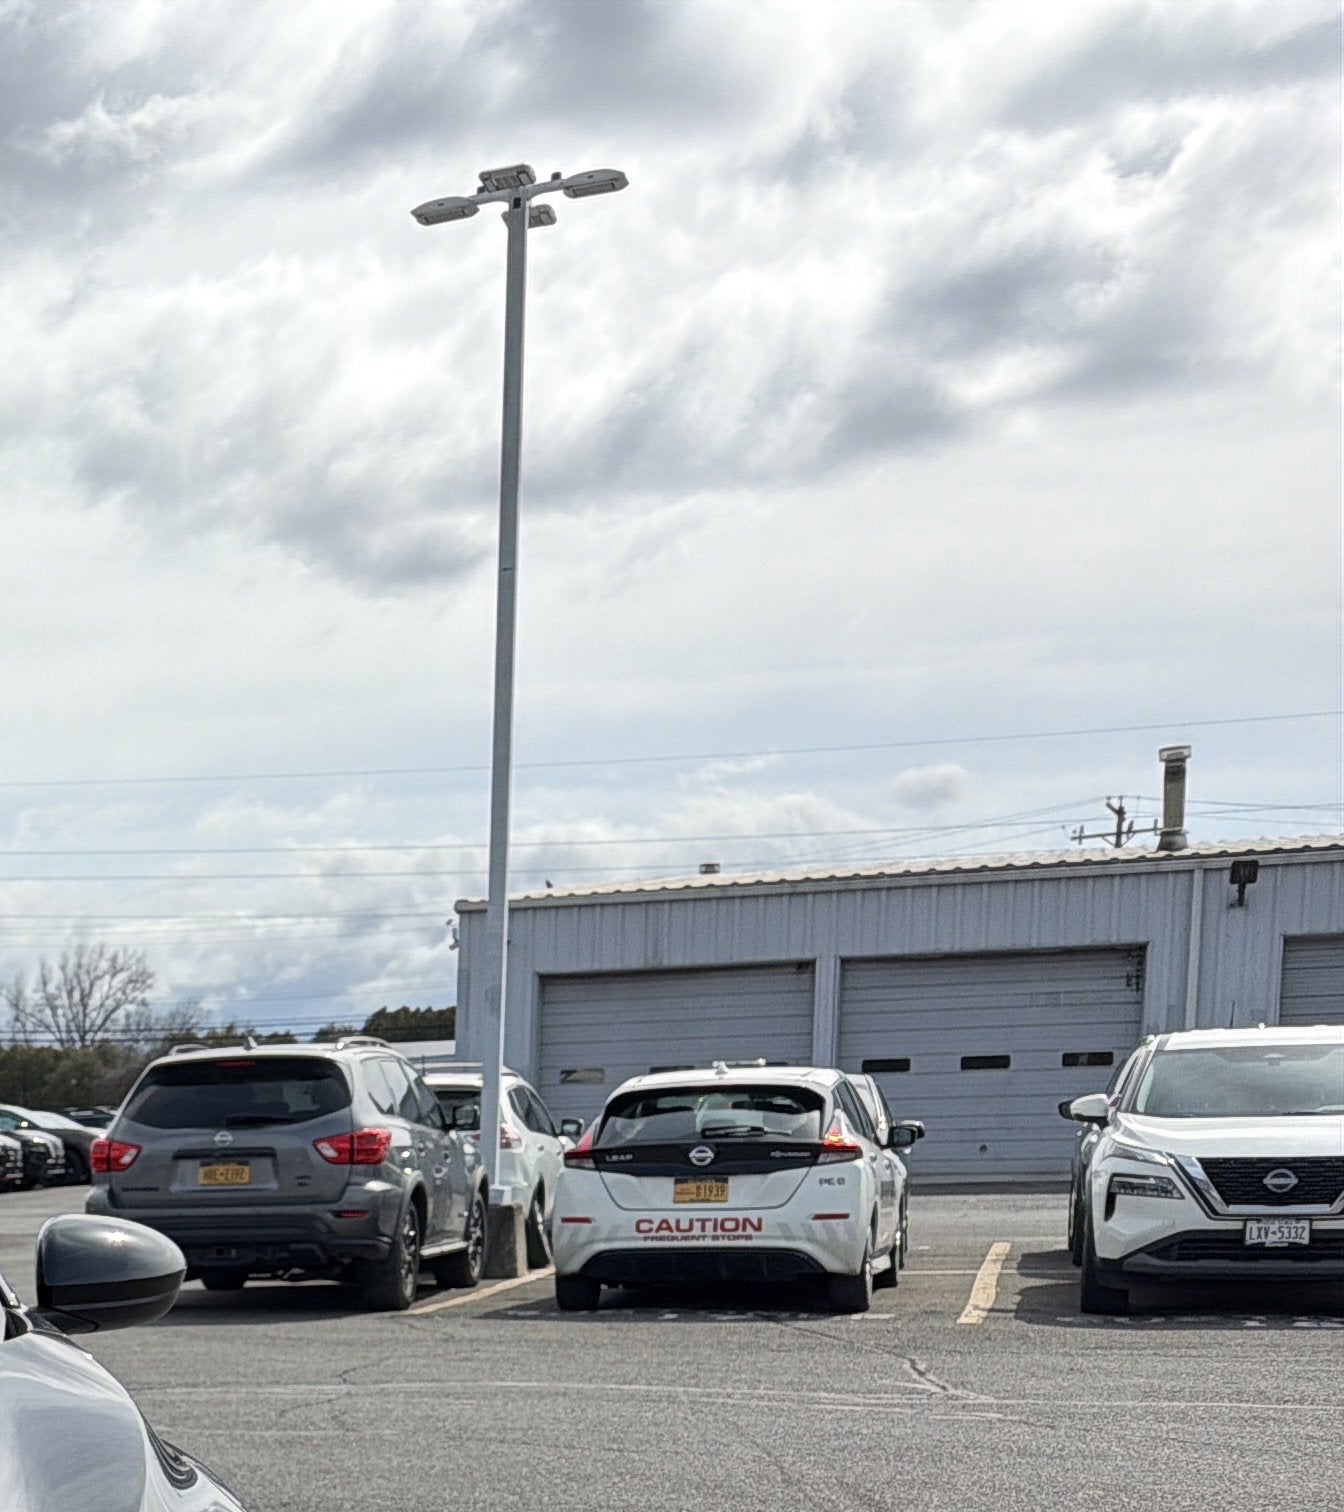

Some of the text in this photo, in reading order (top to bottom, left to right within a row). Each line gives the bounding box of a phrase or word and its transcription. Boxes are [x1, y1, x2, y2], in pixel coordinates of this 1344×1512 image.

[635, 1217, 763, 1234] CAUTION
[643, 1233, 754, 1242] FREQUENT STOPS
